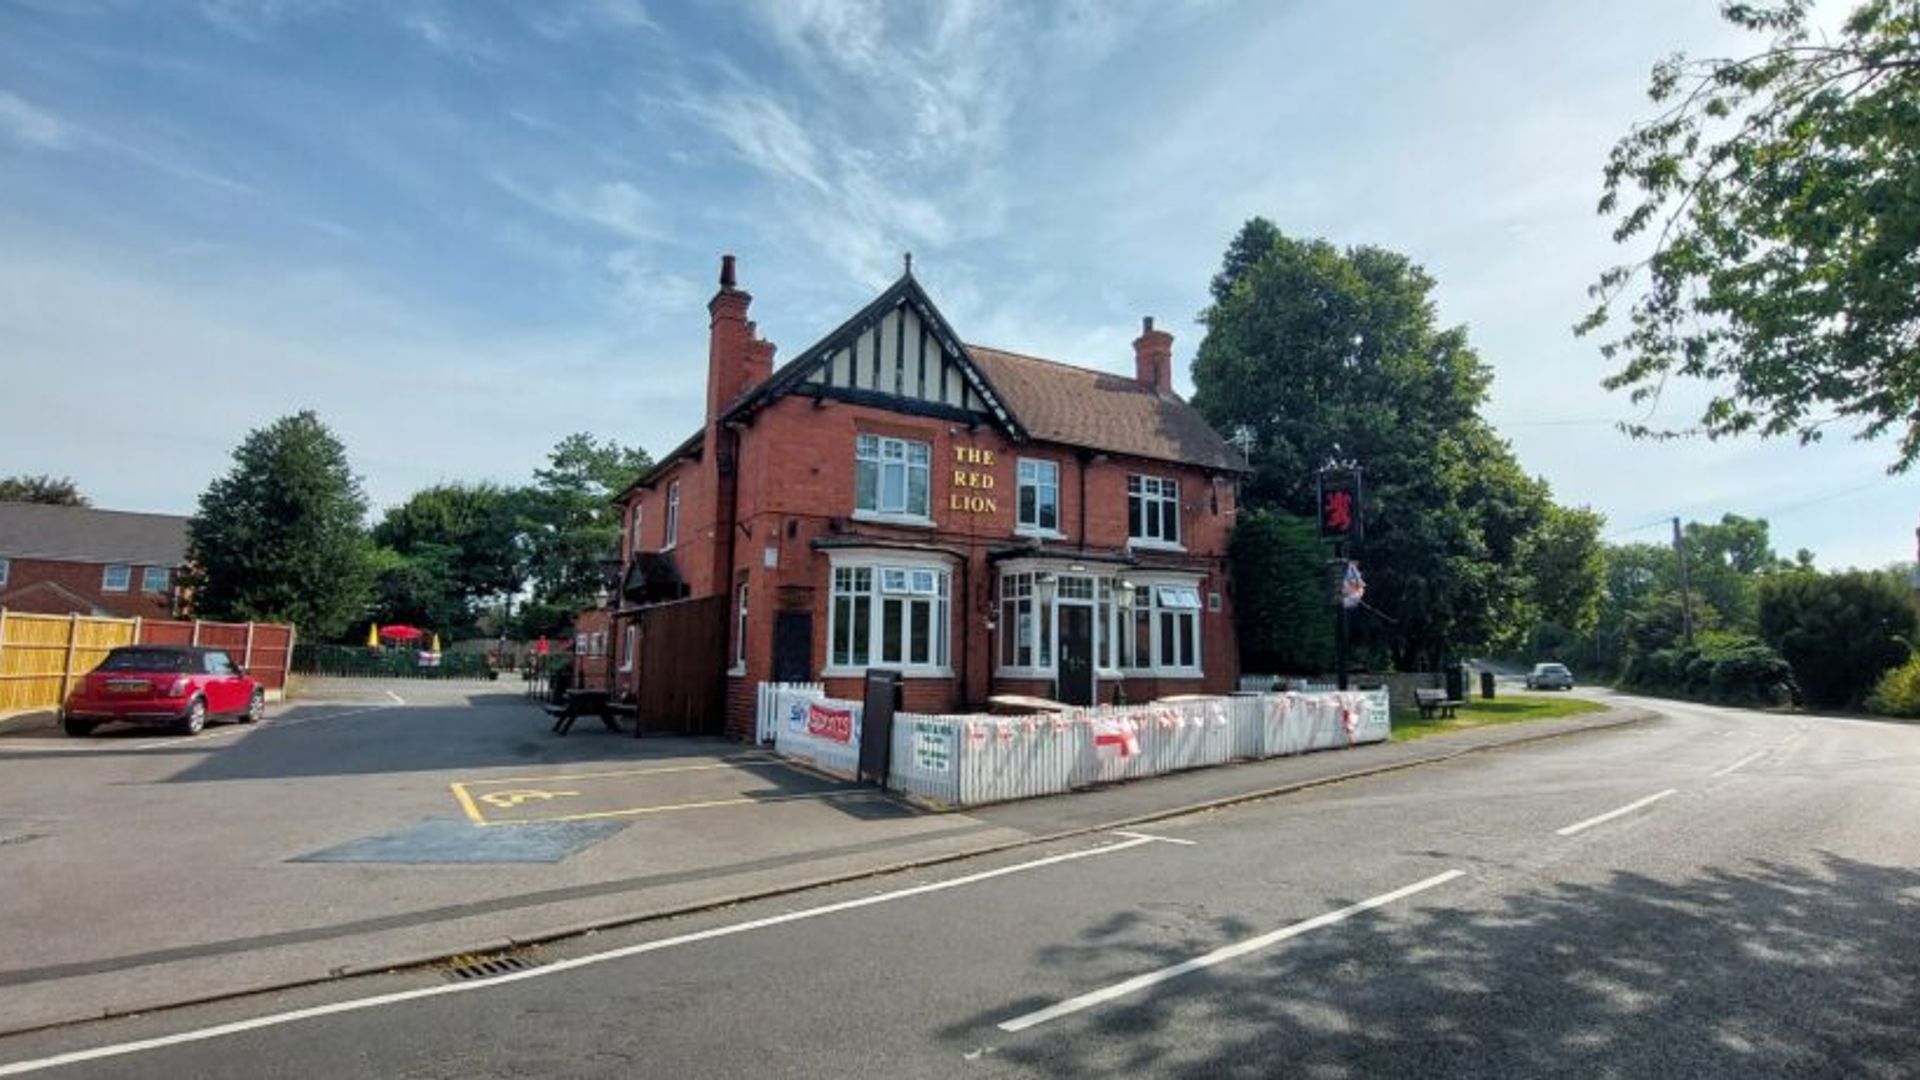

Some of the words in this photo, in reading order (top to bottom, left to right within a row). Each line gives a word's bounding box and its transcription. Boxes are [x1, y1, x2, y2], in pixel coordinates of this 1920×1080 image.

[954, 446, 994, 465] THE
[954, 471, 995, 489] RED
[950, 494, 997, 513] LION
